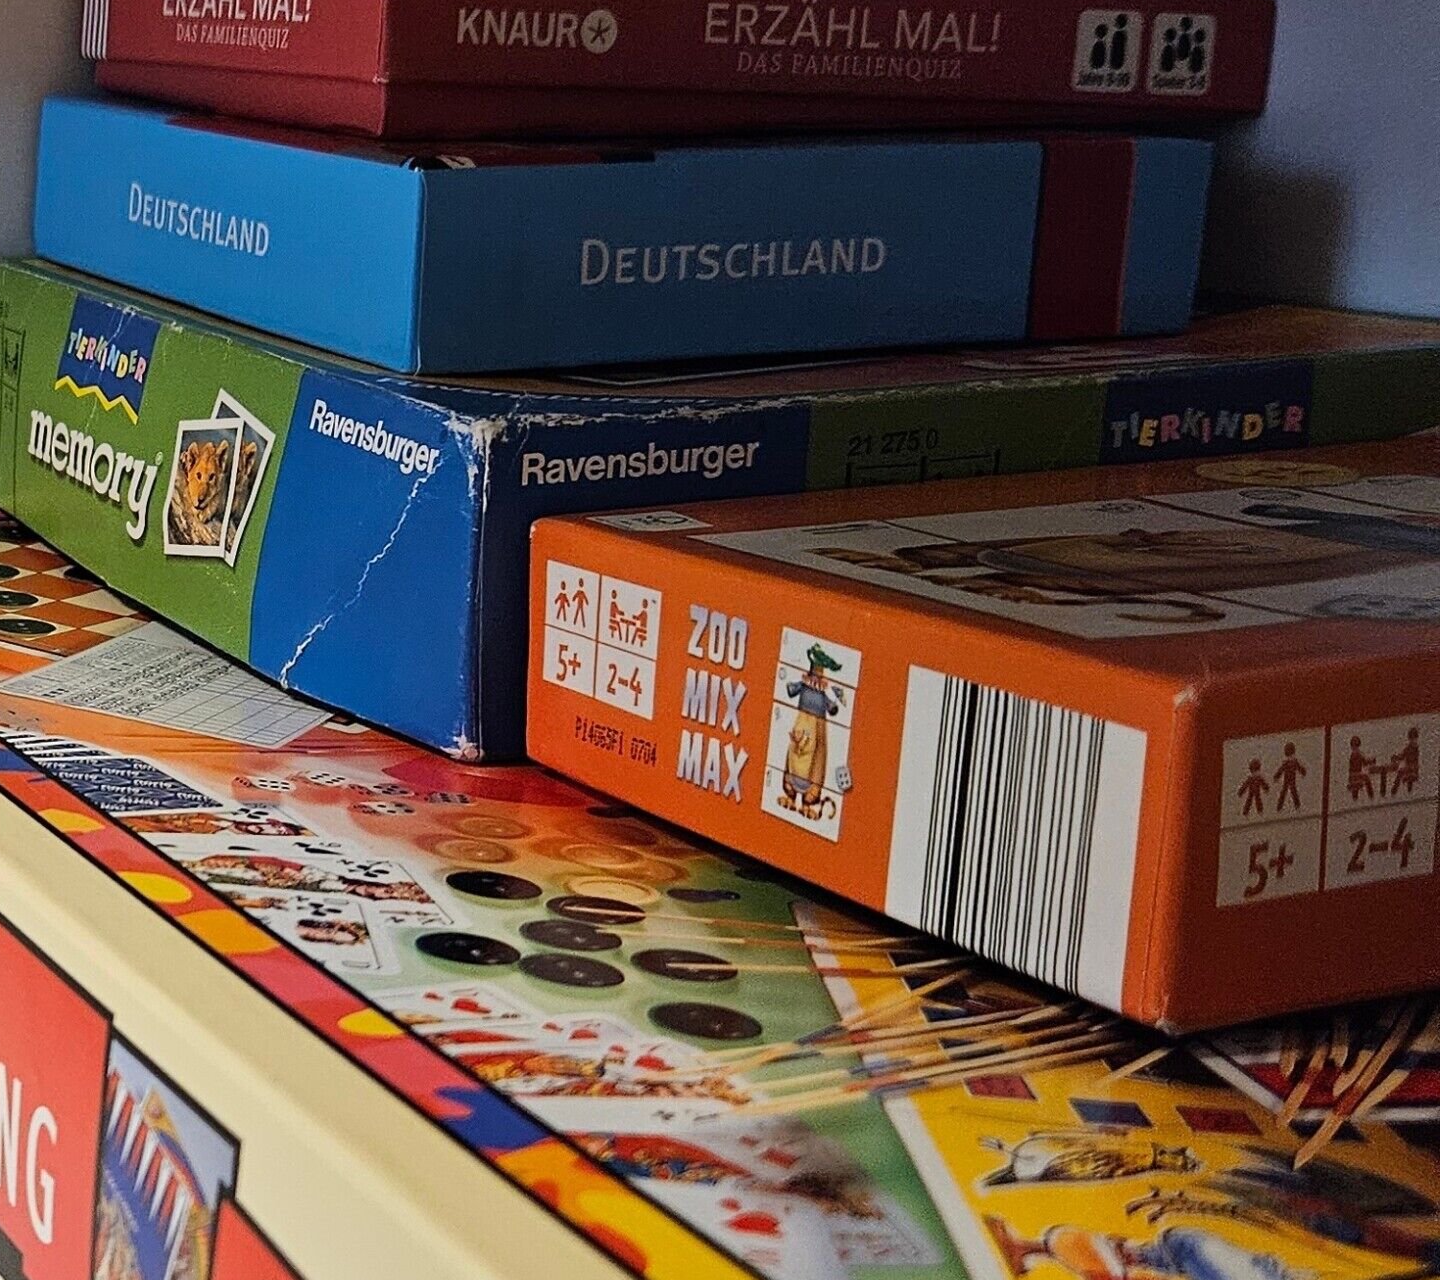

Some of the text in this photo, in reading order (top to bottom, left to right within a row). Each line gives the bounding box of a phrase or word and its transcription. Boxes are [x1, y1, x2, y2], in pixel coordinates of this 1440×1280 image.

[176, 23, 290, 49] DAS FAMILIENQUIZ
[457, 8, 580, 49] KNAUR
[894, 9, 1001, 54] MAL!
[736, 51, 962, 81] DAS FAMILIENQUIZ
[68, 328, 148, 385] TIERKINDER
[310, 398, 444, 476] Ravensburger
[848, 434, 872, 456] 21
[881, 429, 921, 454] 275
[1109, 400, 1306, 450] TIERKINDER
[28, 408, 158, 542] memory
[519, 438, 759, 489] Ravensburger
[687, 603, 749, 671] ZOO
[555, 644, 582, 682] 5+
[607, 662, 643, 707] 2-4
[681, 667, 747, 737] MIX
[676, 729, 749, 804] MAX
[1242, 840, 1295, 898] 5+
[1346, 817, 1415, 875] 2-4
